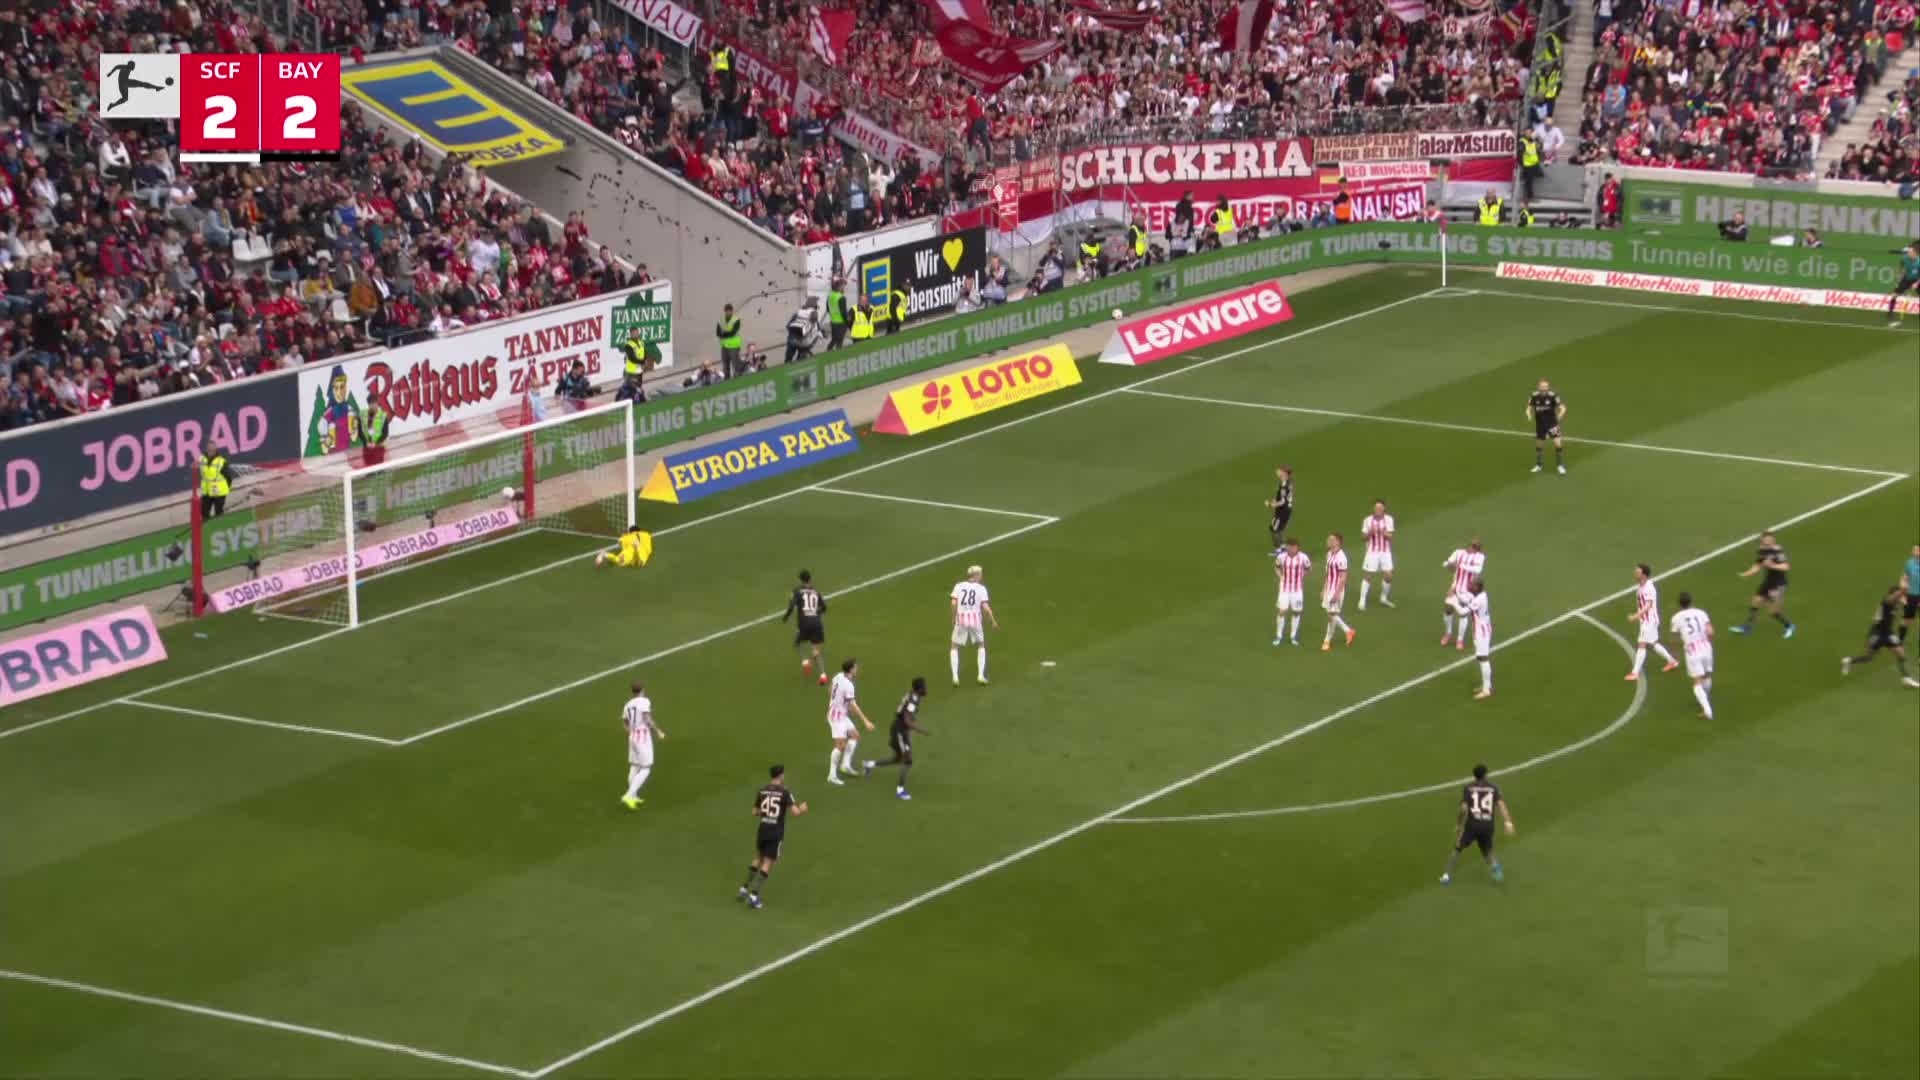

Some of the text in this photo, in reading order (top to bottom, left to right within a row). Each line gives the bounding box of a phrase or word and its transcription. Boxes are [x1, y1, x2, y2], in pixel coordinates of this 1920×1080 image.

[616, 0, 697, 40] NAU
[1419, 131, 1515, 156] alarMstufe
[1060, 140, 1312, 192] SCHICKERIA
[1296, 189, 1421, 221] RANAU/SN
[915, 248, 940, 279] Wir
[1184, 231, 1614, 286] HERRENKNECHT TUNNELLING SYSTEMS
[1502, 262, 1595, 286] WeberHaus
[1630, 240, 1897, 284] Tunneln wie die Pro
[1605, 271, 1701, 294] WeberHaus
[1711, 280, 1805, 305] WeberHau
[614, 304, 669, 325] TANNEN
[824, 280, 1142, 385] HERRENKNECHT TUNNELLING SYSTEMS
[1124, 288, 1283, 356] Lexware
[504, 315, 604, 362] TANNEN
[614, 324, 667, 345] ZÄFLE
[509, 348, 601, 395] ZÄPFE
[961, 354, 1053, 400] LOTTO
[363, 355, 499, 425] Rothaus
[562, 405, 686, 460] TUNNLING
[690, 380, 777, 422] SYSTEMS
[79, 404, 269, 491] JOBRAD
[669, 418, 852, 490] EUROPA PARK
[0, 458, 41, 512] D
[211, 503, 323, 557] SYSTEMS
[453, 509, 510, 540] JOBRAD
[379, 531, 439, 561] JOBRAD
[225, 575, 284, 607] JOBRAD
[802, 591, 819, 611] 10
[960, 588, 976, 606] 28
[1684, 616, 1702, 635] 31
[0, 617, 152, 694] BRAD
[760, 795, 781, 818] 45
[1471, 791, 1493, 815] 14
